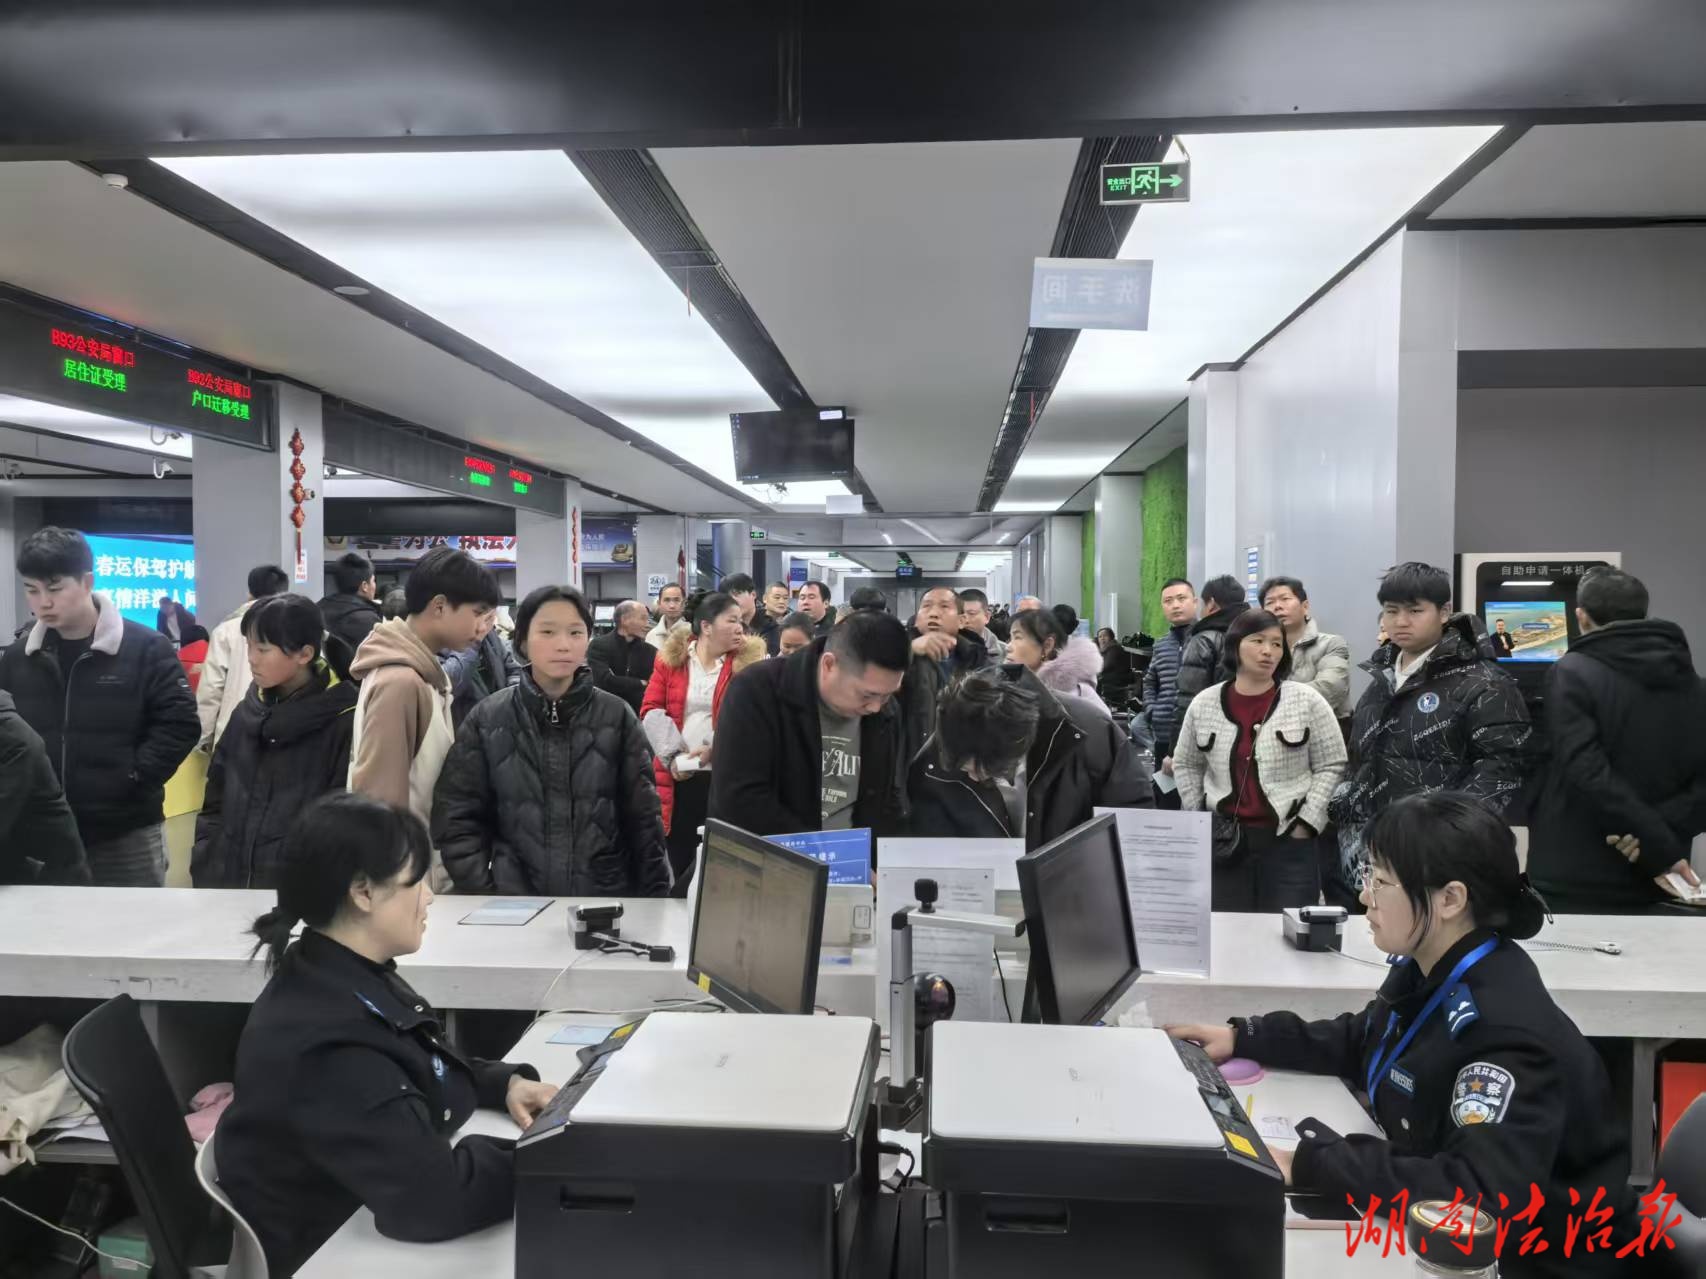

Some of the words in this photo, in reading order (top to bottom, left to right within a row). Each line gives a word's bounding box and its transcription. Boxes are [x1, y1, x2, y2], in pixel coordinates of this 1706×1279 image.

[64, 358, 127, 392] 居住证受理
[191, 389, 251, 421] 户口迁移受理
[1501, 564, 1585, 576] 自助申请一体机
